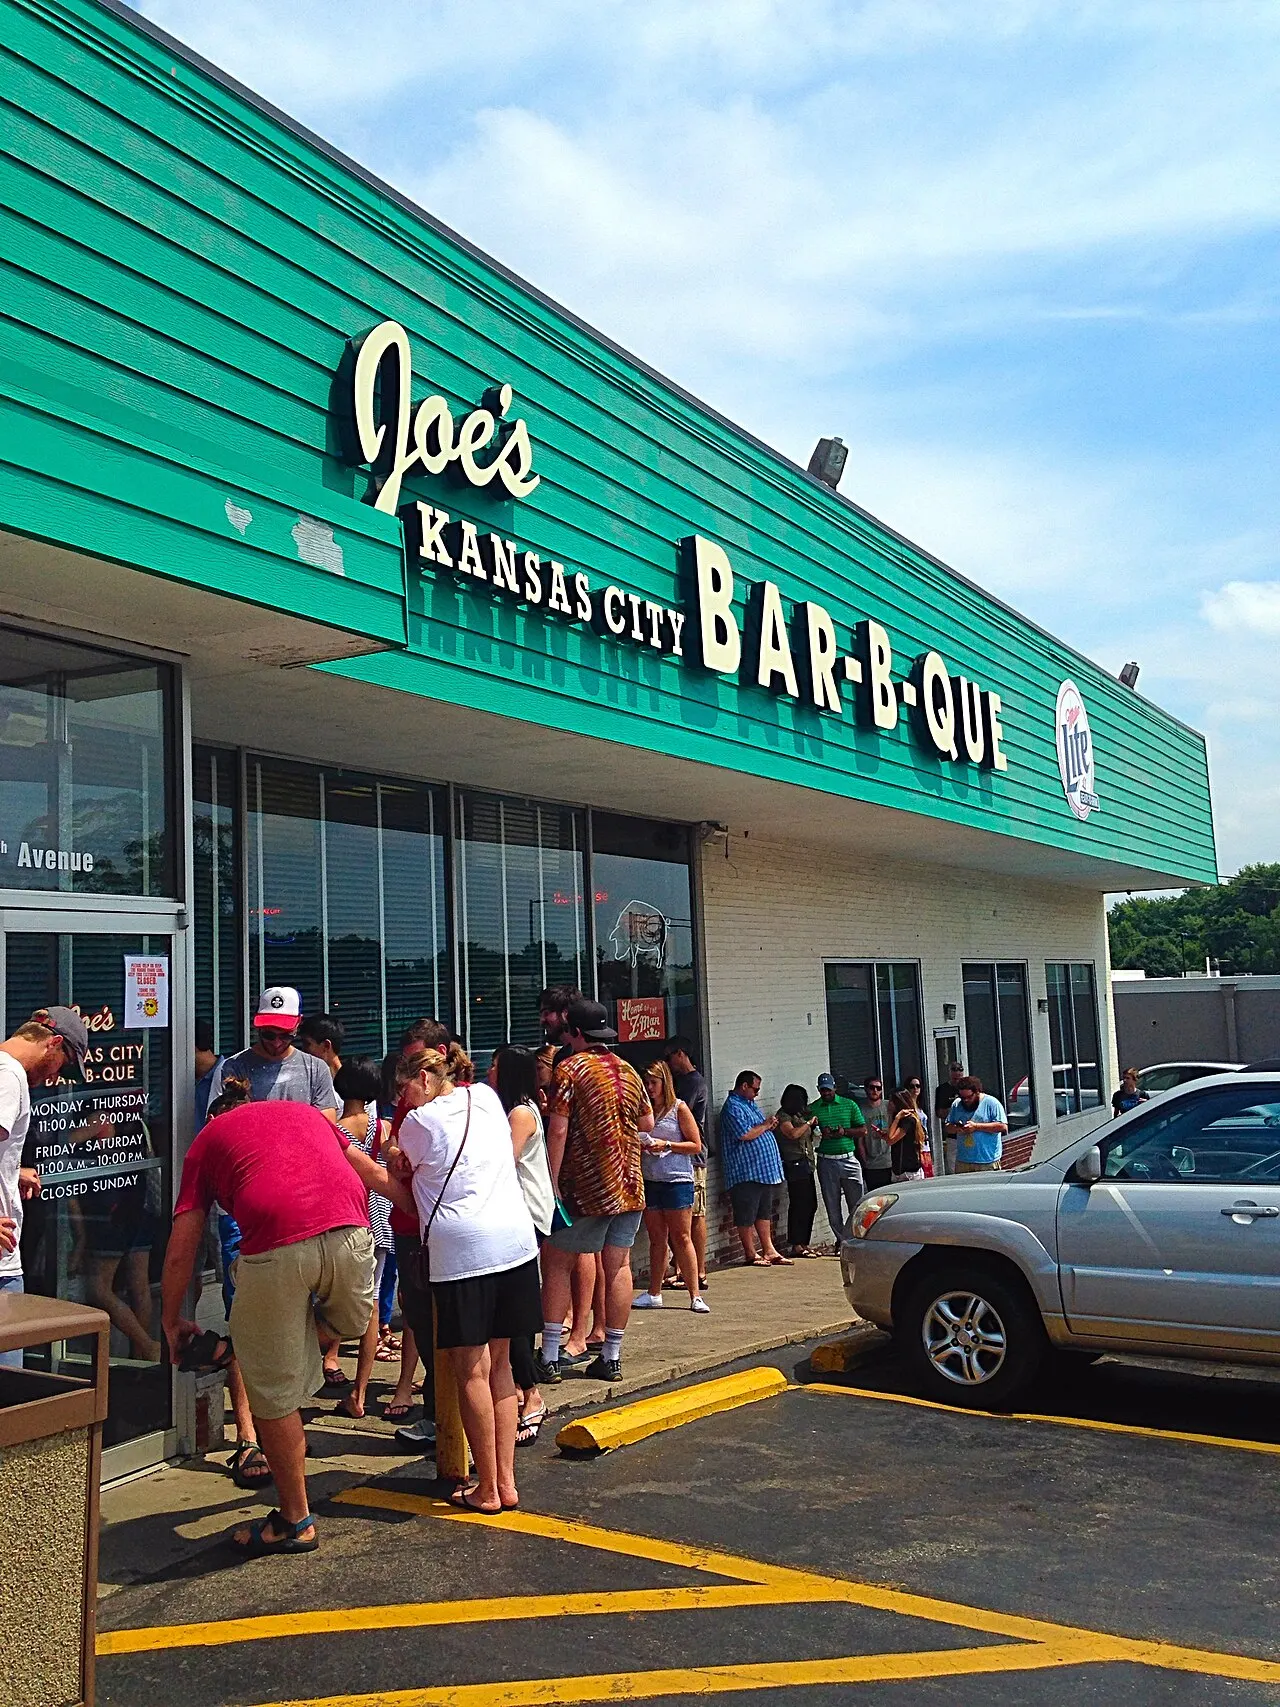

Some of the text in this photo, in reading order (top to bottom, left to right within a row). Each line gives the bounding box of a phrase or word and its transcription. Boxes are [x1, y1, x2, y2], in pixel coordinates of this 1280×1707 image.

[355, 321, 540, 516] Joe's
[416, 500, 1008, 772] KANSAS CITY BAR-B-QUE
[1061, 722, 1091, 794] Lite
[17, 842, 94, 872] Avenue
[621, 999, 643, 1021] Home
[110, 1045, 144, 1061] CITY
[30, 1100, 84, 1117] MONDAY
[92, 1093, 150, 1110] THURSDAY
[38, 1118, 67, 1133] 11:00
[69, 1118, 91, 1129] A.M.
[99, 1112, 124, 1125] 9:00
[125, 1112, 143, 1122] P.M.
[35, 1142, 77, 1159] FRIDAY
[85, 1133, 144, 1152] SATURDAY
[36, 1160, 64, 1175] 11:00
[66, 1160, 88, 1171] A.M.
[97, 1152, 126, 1166] 10:00
[128, 1151, 145, 1162] P.M.
[40, 1174, 138, 1201] CLOSED SUNDAY
